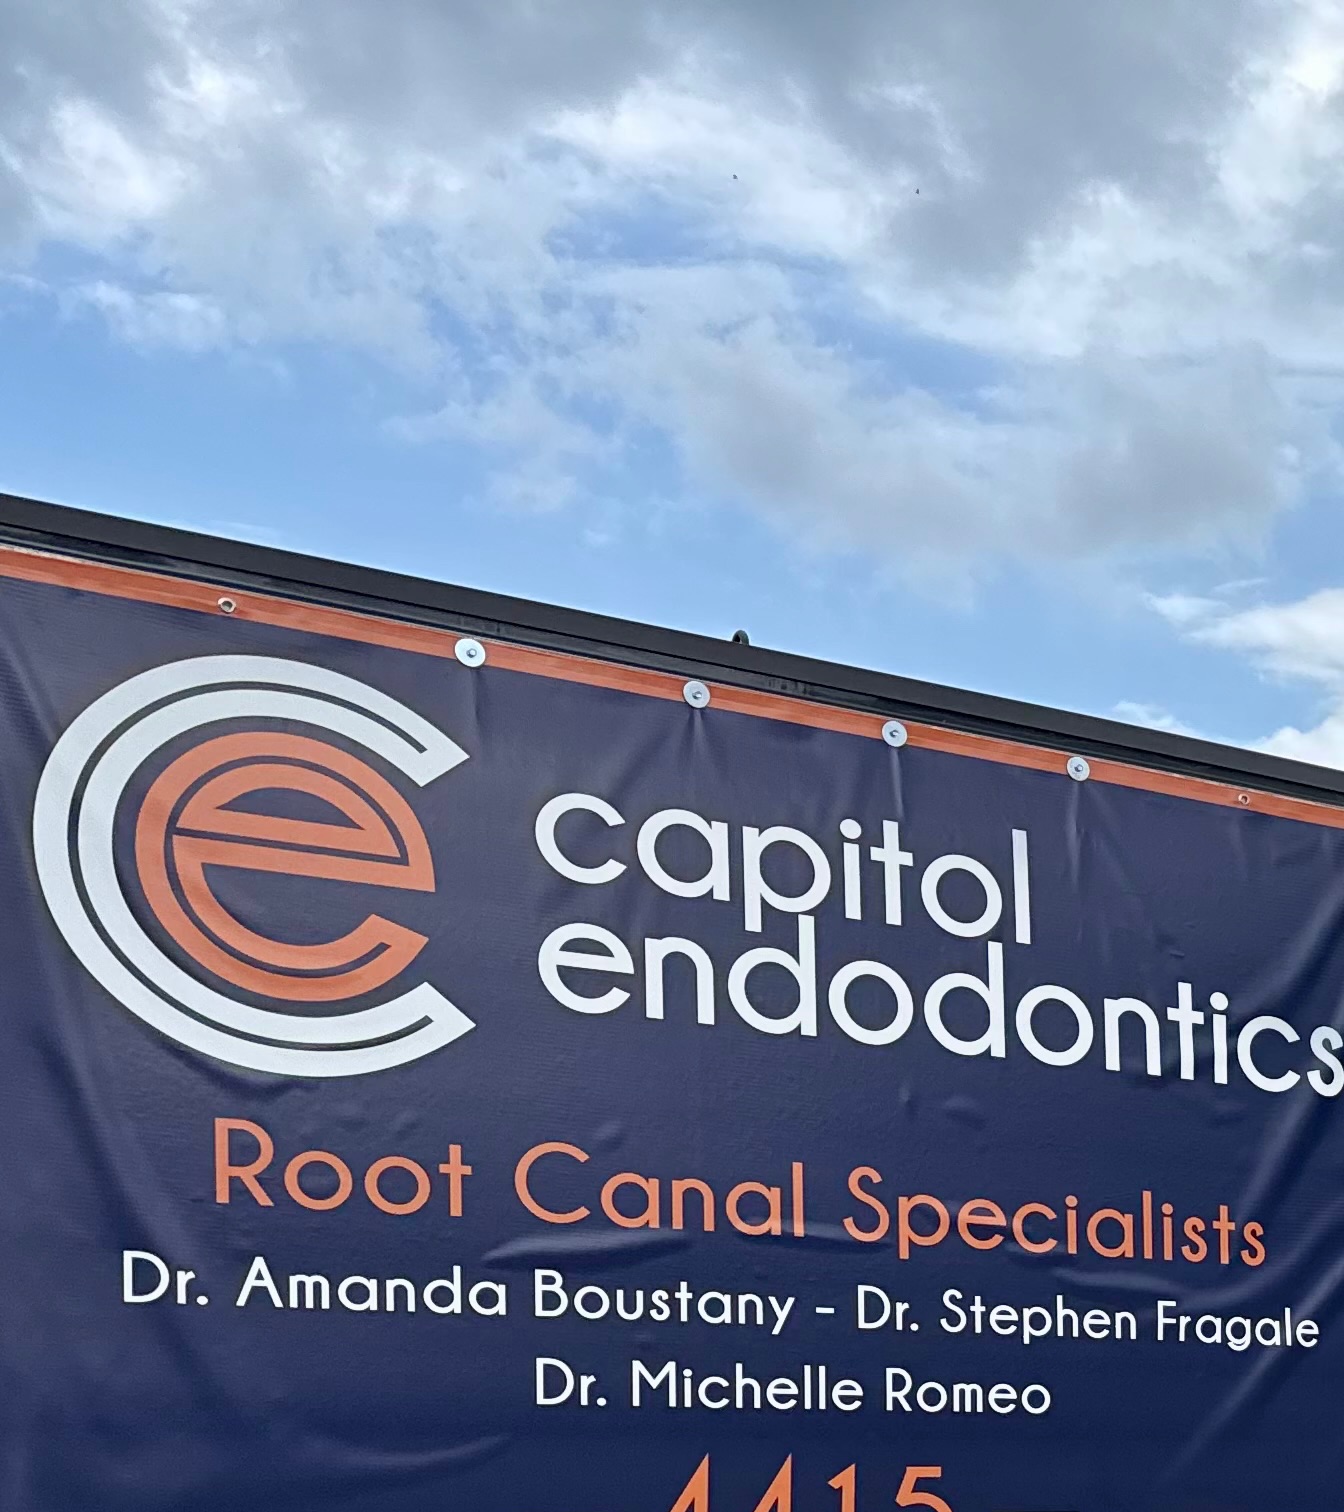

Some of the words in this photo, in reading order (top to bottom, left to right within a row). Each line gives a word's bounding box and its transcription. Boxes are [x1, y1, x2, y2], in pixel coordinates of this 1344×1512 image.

[534, 792, 1031, 945] capitol
[537, 914, 1344, 1097] endodontics
[215, 1118, 472, 1217] Root
[515, 1142, 804, 1237] Canal
[844, 1166, 1265, 1266] Specialists
[123, 1250, 209, 1306] Dr.
[235, 1256, 507, 1316] Amanda
[534, 1268, 795, 1335] Boustany
[857, 1284, 919, 1332] Dr.
[940, 1288, 1137, 1345] Stephen
[1157, 1300, 1320, 1352] Fragale
[535, 1357, 607, 1407] Dr.
[631, 1359, 864, 1411] Michelle
[885, 1367, 1051, 1414] Romeo
